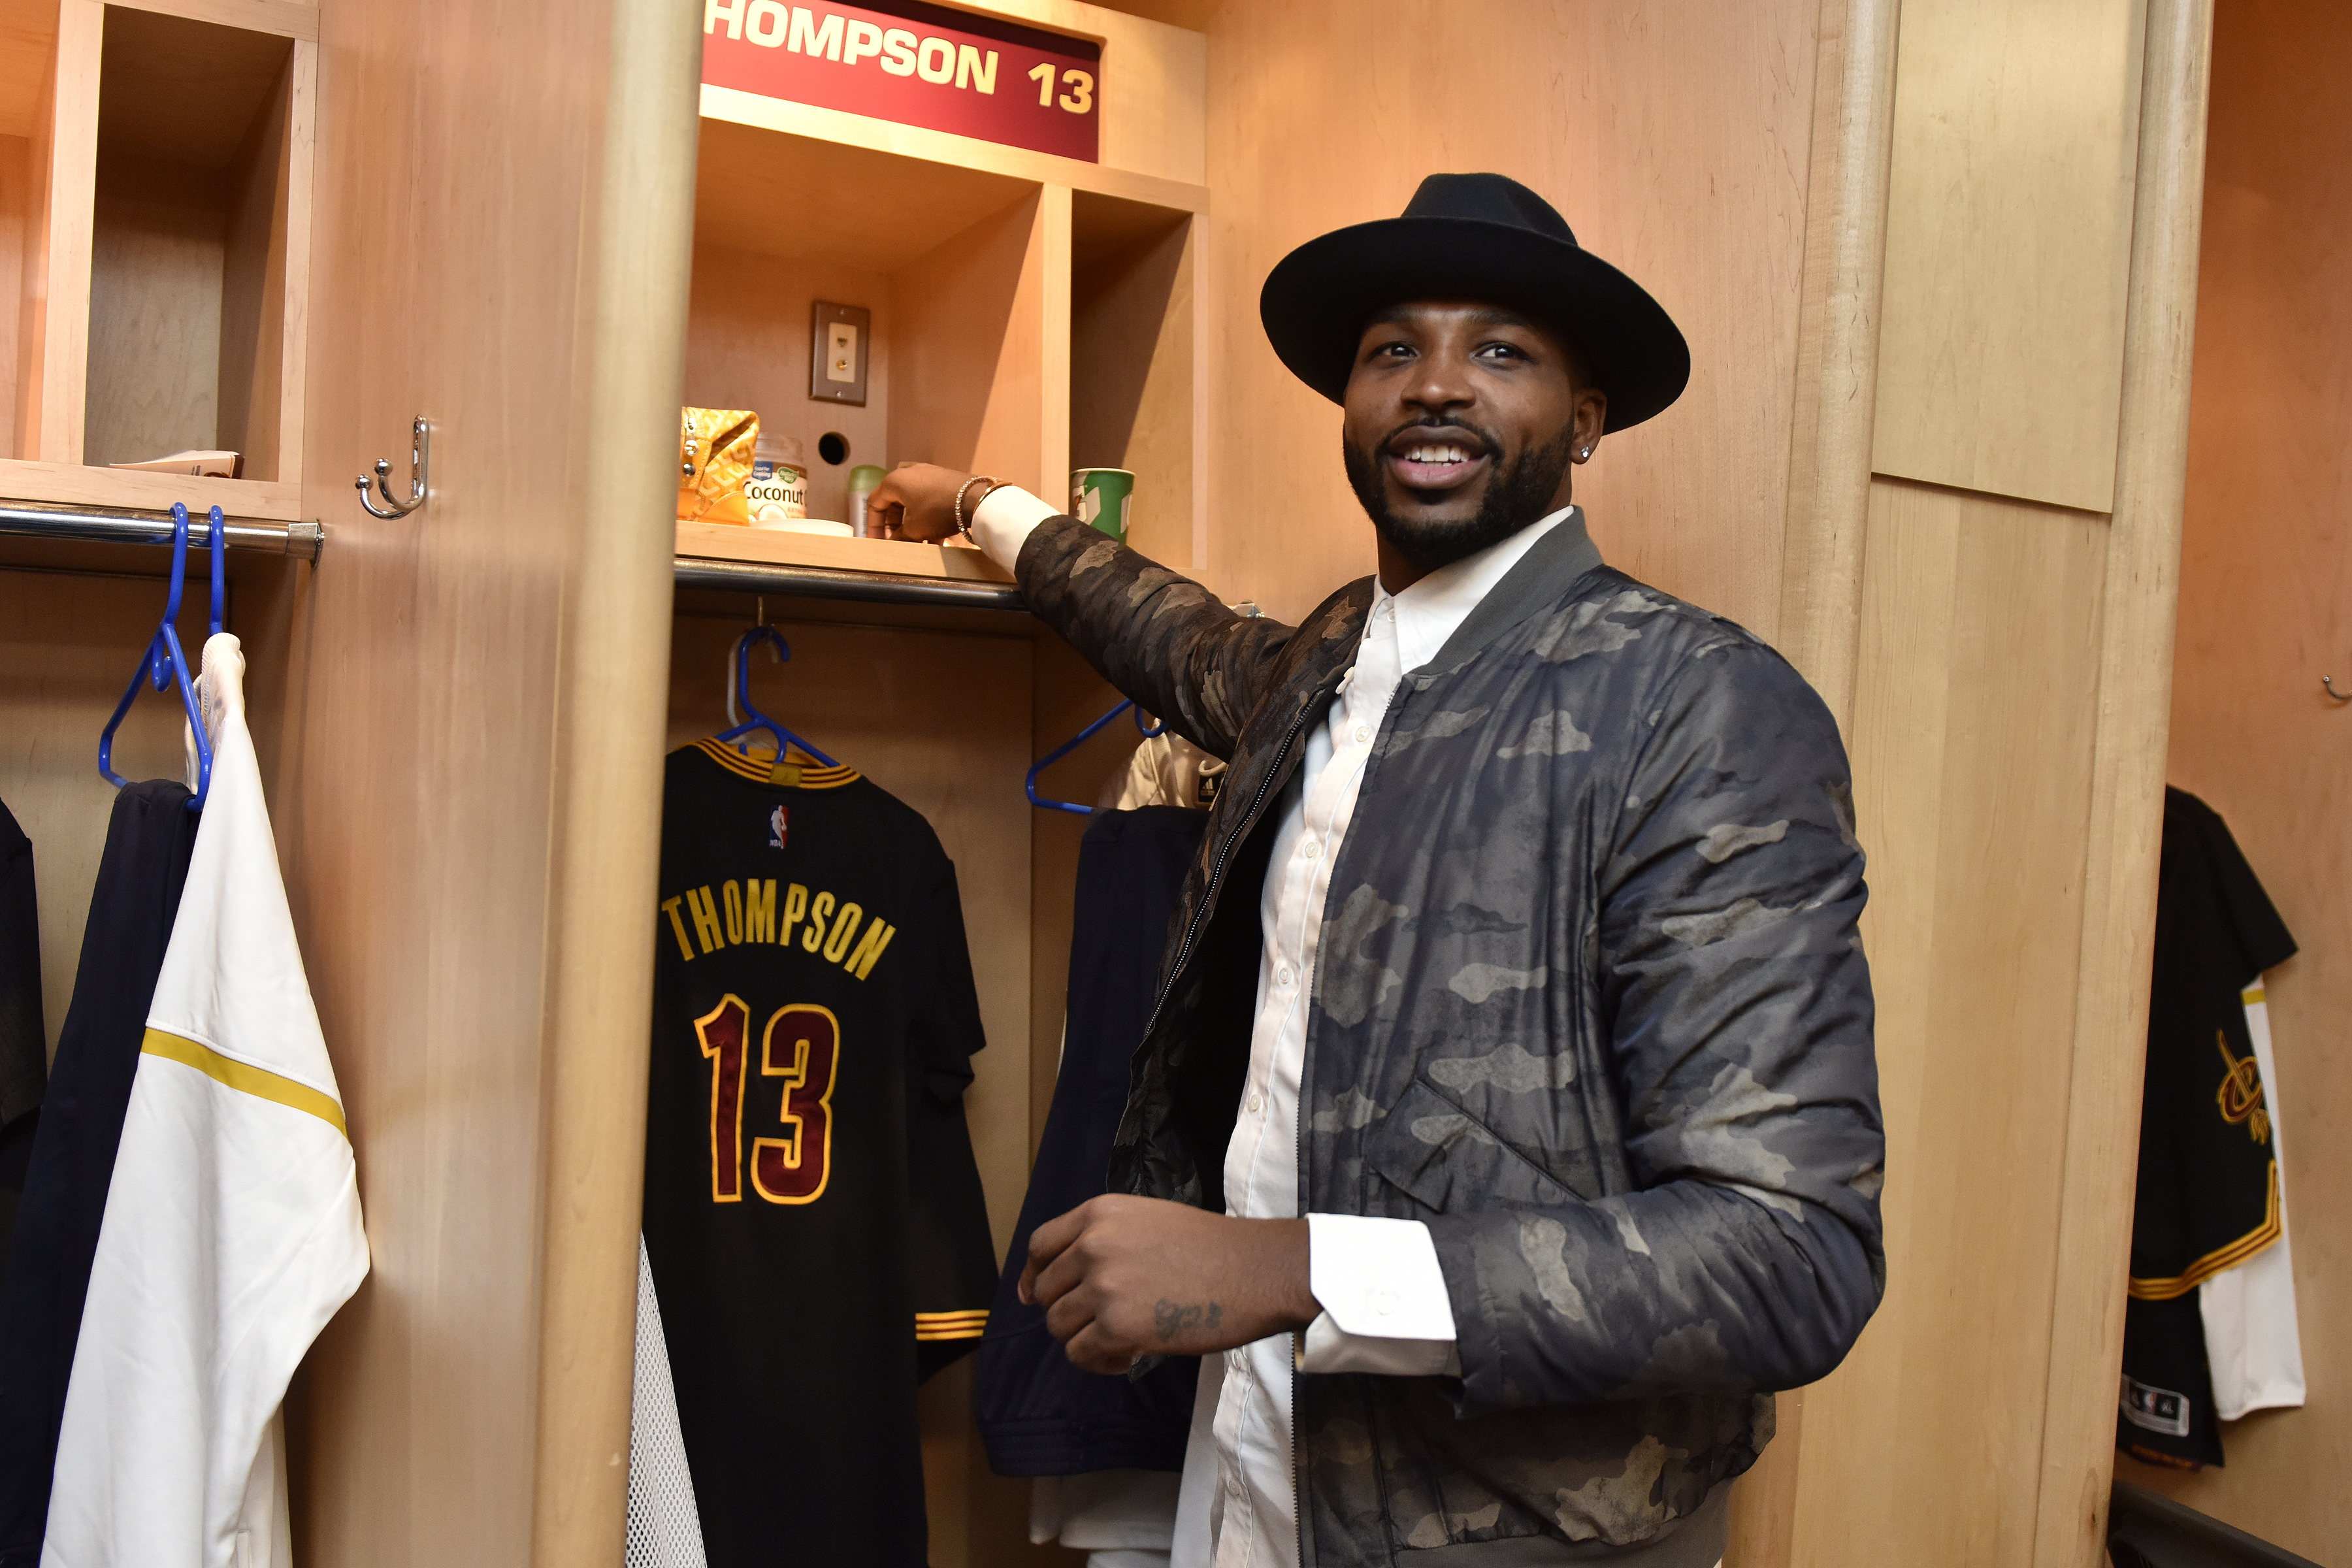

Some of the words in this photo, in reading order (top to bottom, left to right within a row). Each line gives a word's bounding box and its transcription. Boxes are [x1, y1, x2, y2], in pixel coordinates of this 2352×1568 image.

[1028, 62, 1094, 114] 13
[661, 879, 896, 981] THOMPSON
[694, 993, 840, 1205] 13
